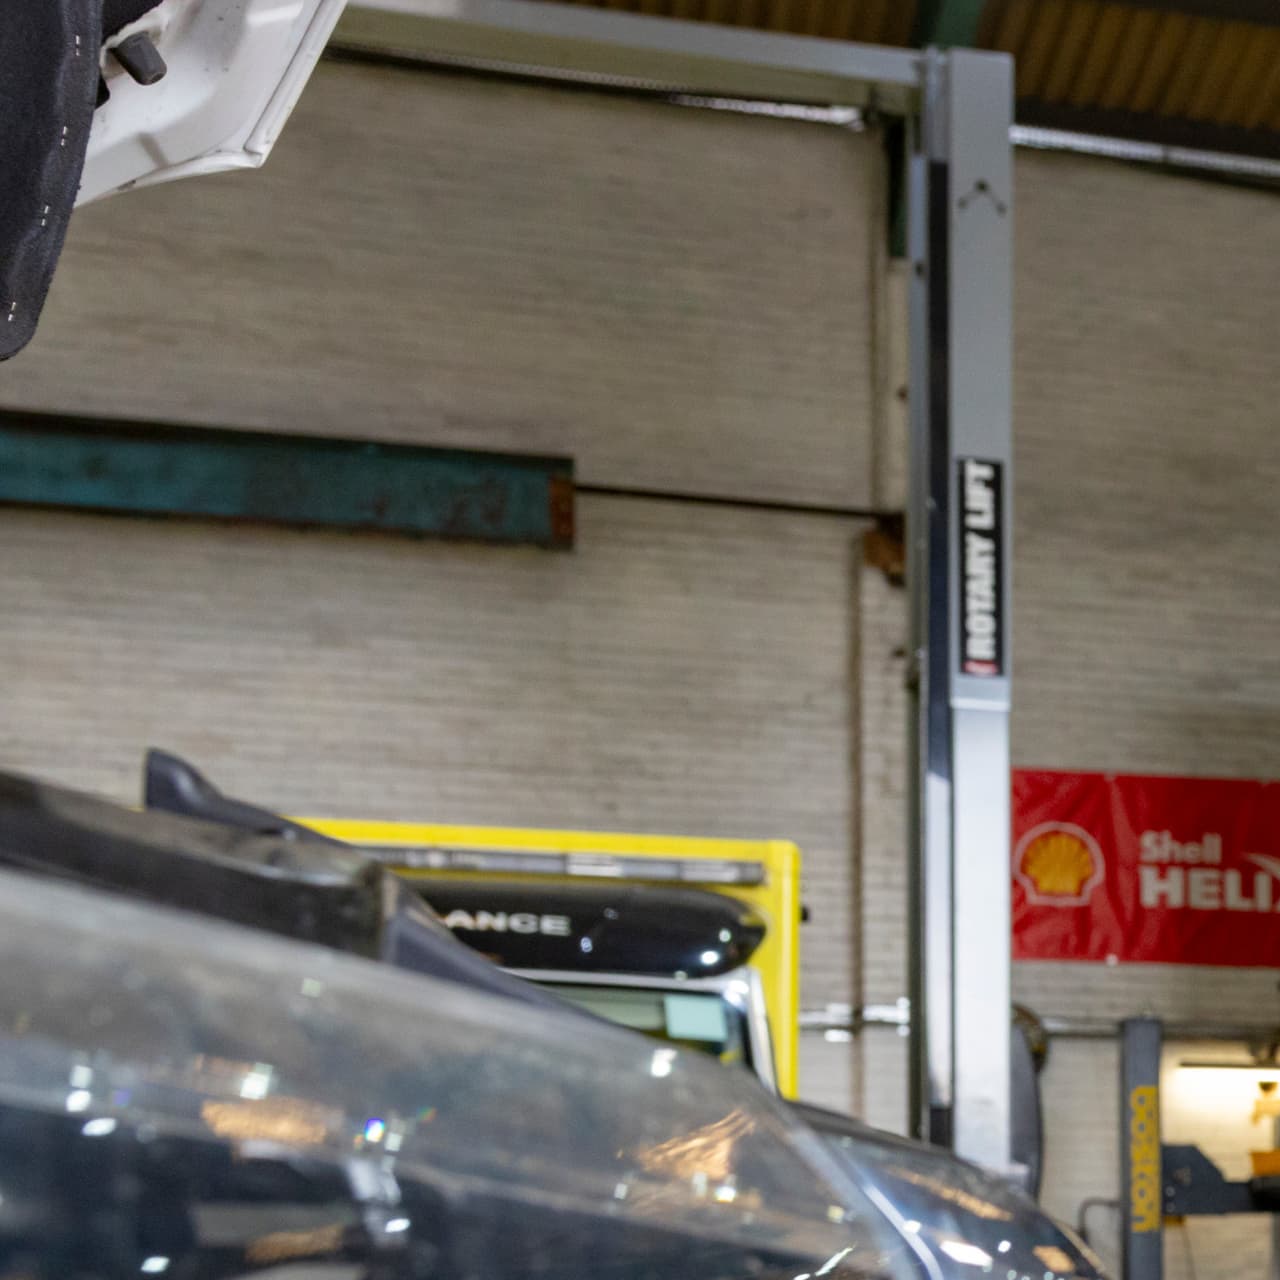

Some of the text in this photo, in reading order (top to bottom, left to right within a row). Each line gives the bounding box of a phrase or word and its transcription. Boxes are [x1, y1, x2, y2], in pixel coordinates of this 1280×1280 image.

[965, 459, 996, 660] ROTARY LIFT
[1139, 829, 1222, 864] Shell
[1130, 1086, 1159, 1232] boston
